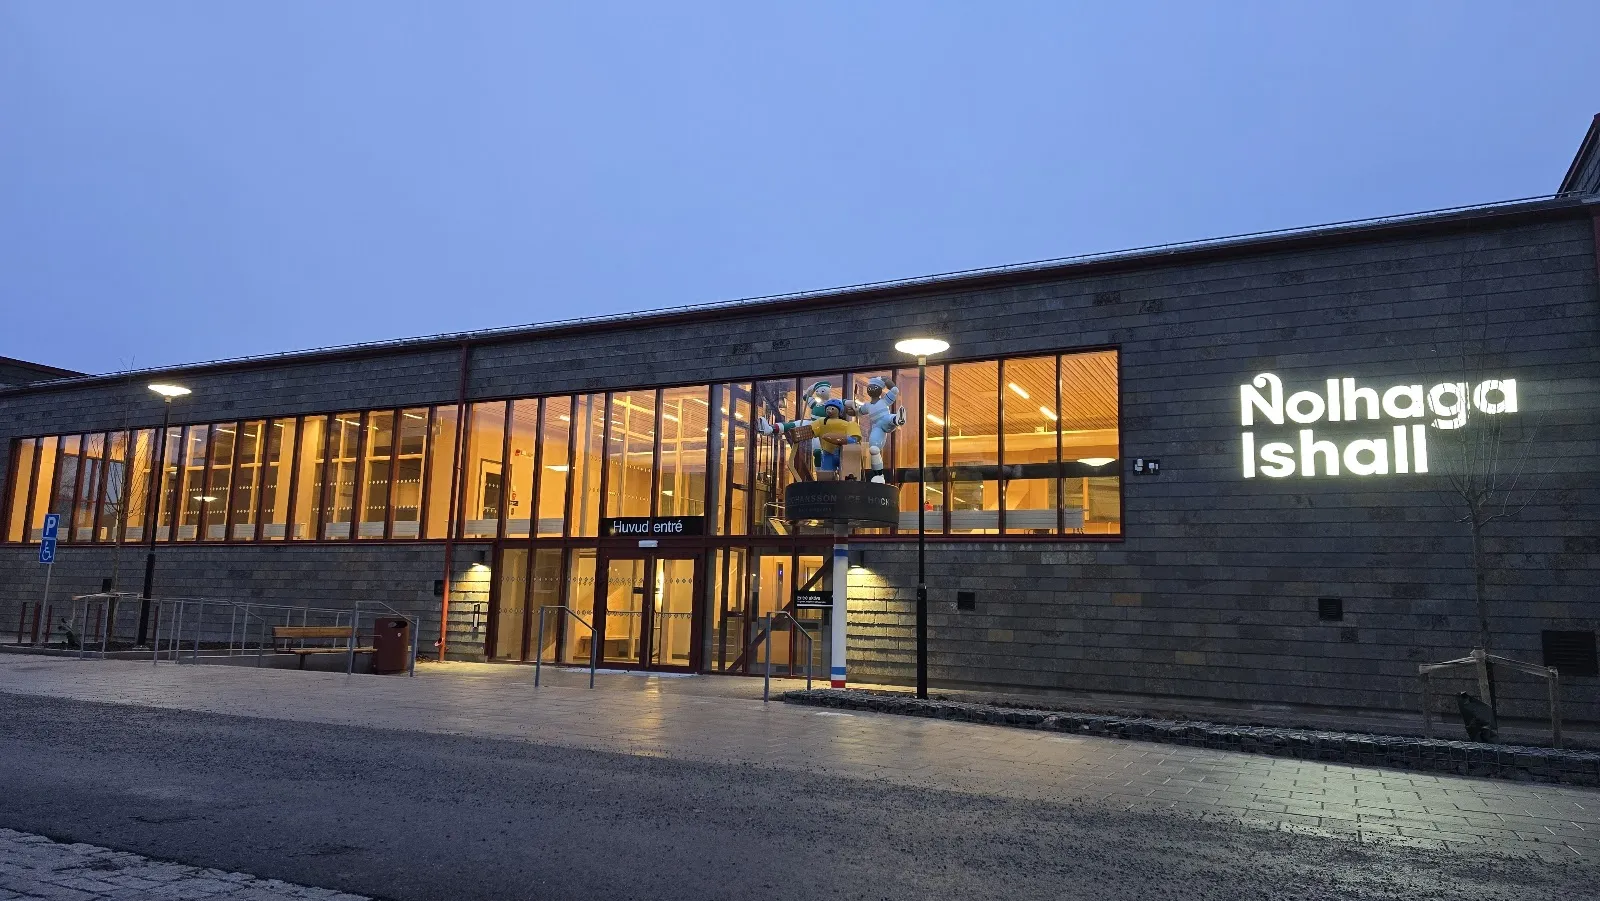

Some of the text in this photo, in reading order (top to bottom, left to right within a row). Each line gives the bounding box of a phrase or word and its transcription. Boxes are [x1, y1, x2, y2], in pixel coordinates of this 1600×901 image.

[1240, 372, 1518, 430] Nolhaga
[1242, 424, 1429, 478] Ishall
[46, 516, 57, 535] P
[613, 519, 683, 533] Huvud entré
